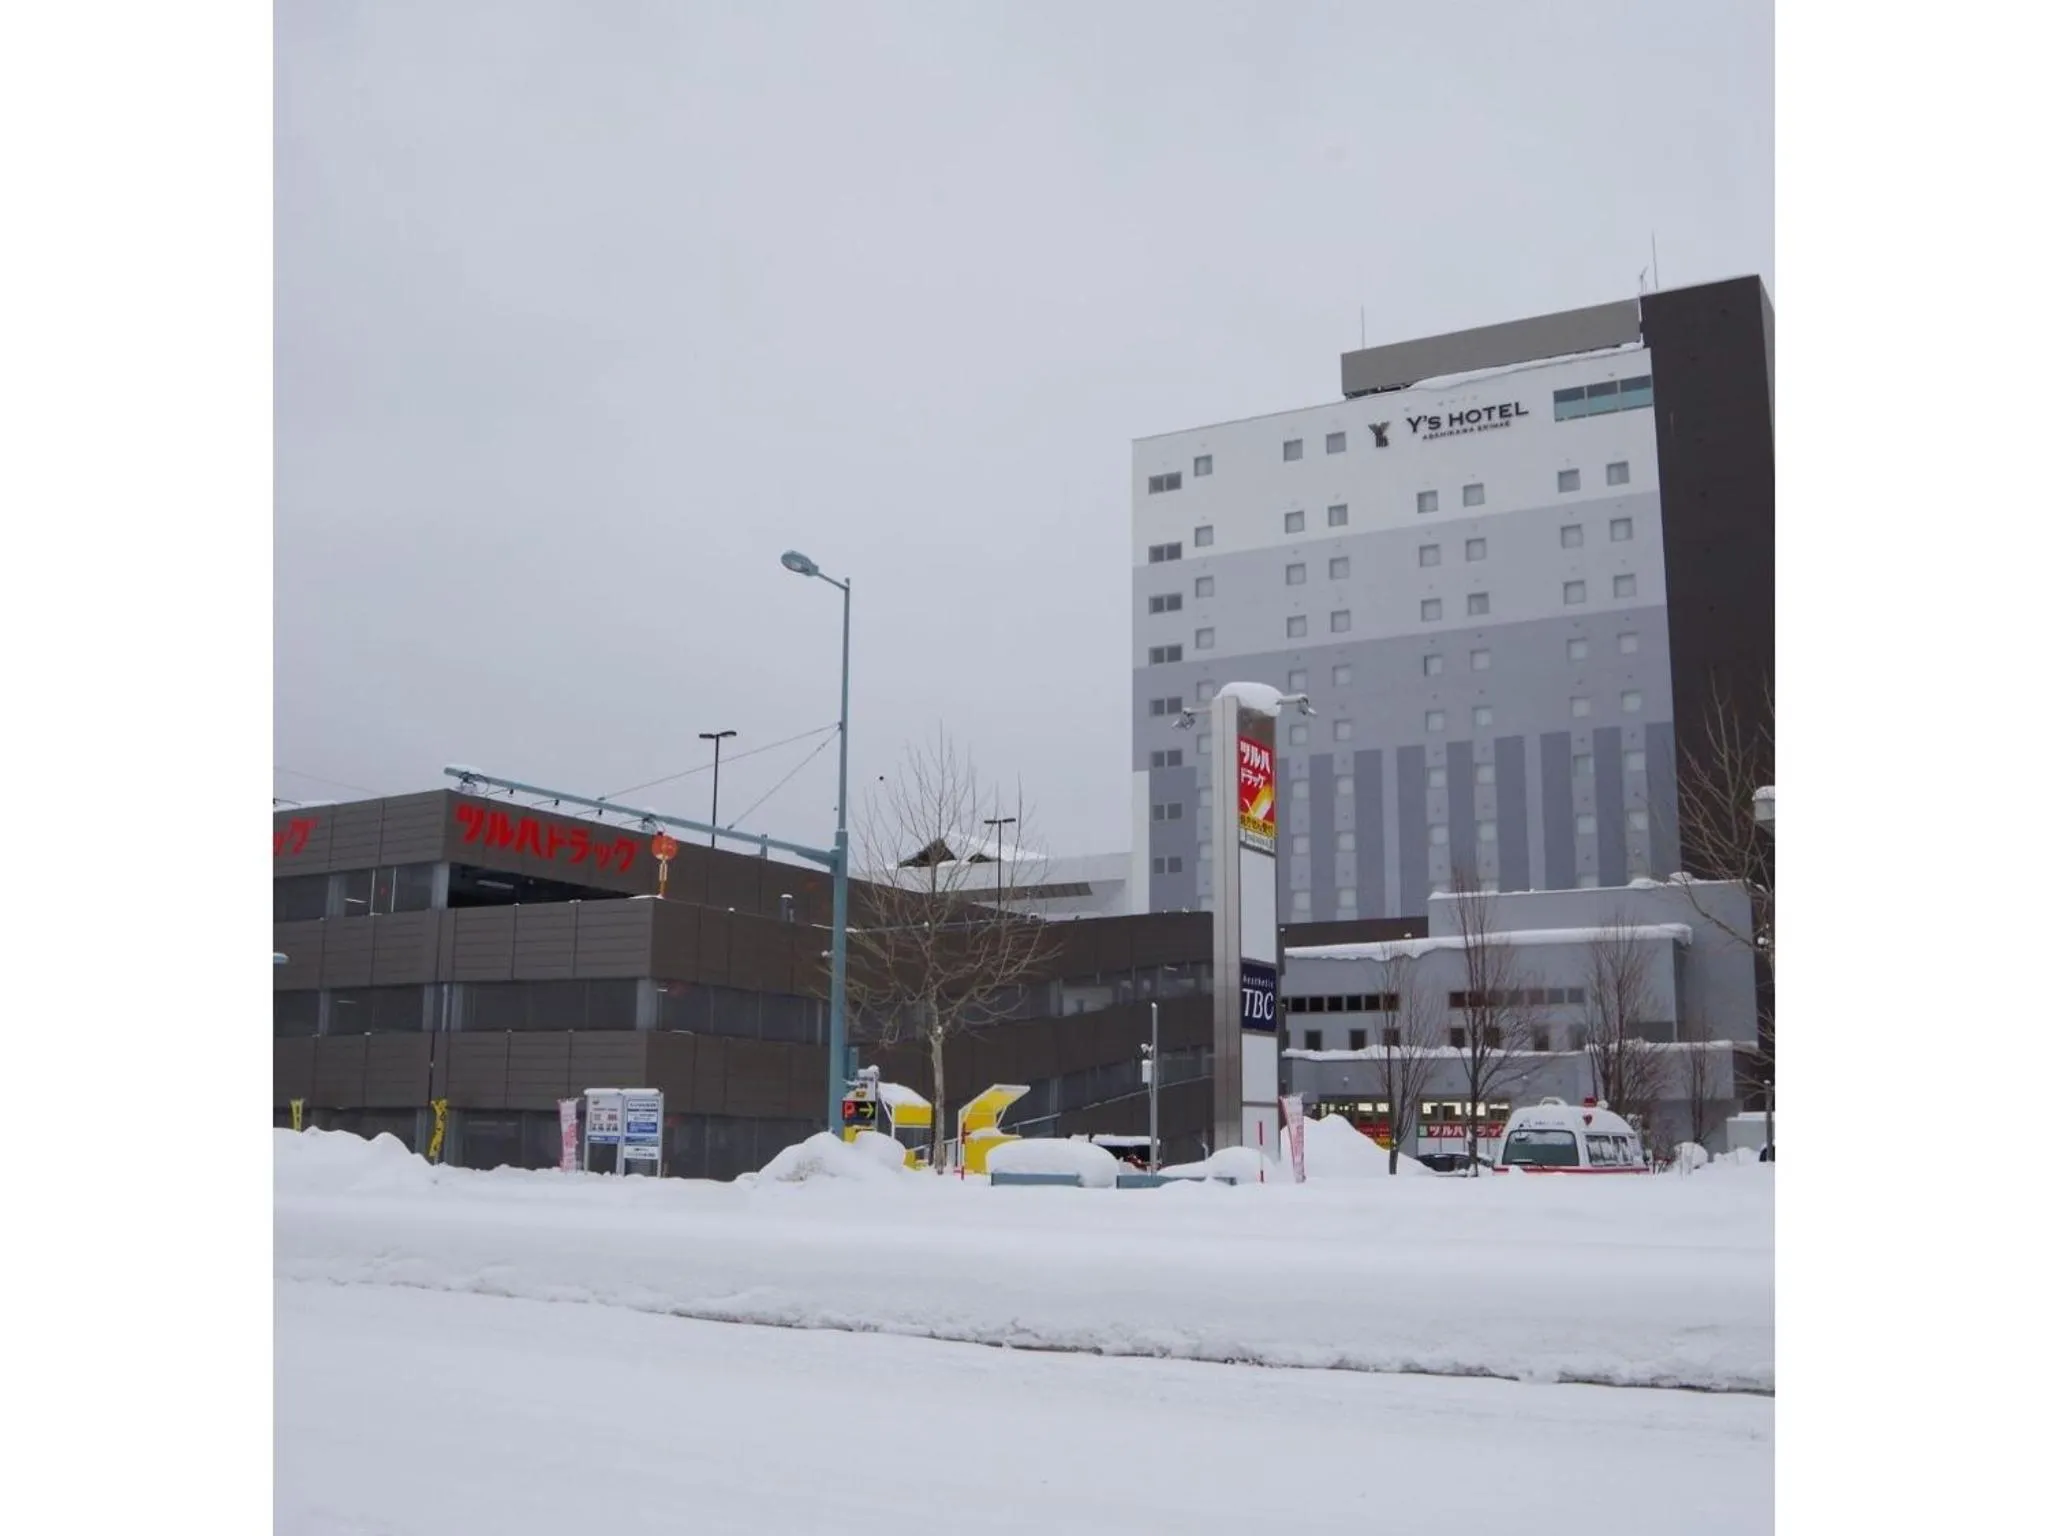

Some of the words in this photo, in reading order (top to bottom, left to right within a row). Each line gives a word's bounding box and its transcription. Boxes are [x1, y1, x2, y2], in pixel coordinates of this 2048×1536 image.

[1406, 414, 1442, 434] Y's
[1449, 401, 1530, 427] HOTEL
[1239, 740, 1272, 774] ツルハ
[456, 803, 643, 875] ツルハドラッグ
[1242, 987, 1275, 1021] TBC
[844, 1101, 856, 1118] P
